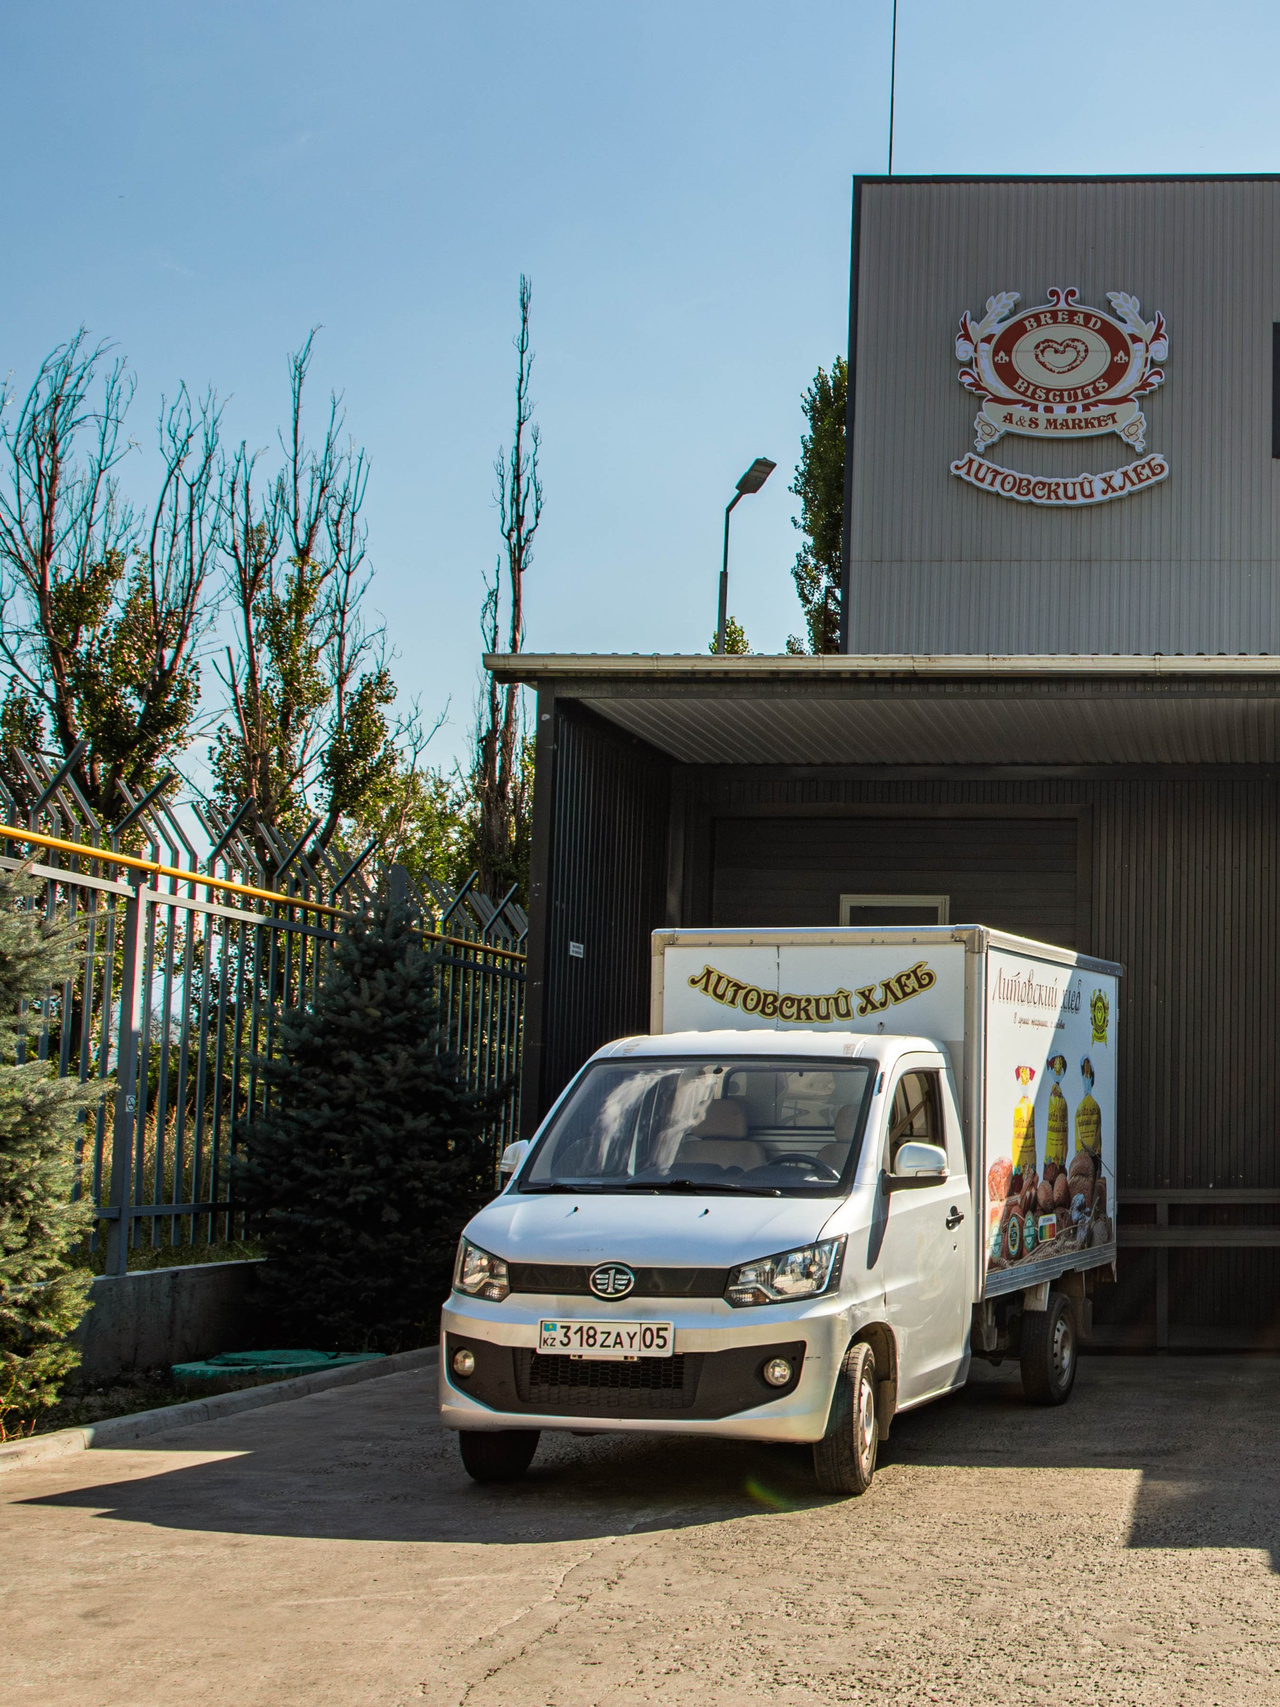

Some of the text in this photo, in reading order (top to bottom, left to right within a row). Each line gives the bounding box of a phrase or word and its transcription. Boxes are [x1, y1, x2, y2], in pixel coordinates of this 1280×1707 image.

[1022, 310, 1102, 333] BREAD
[1013, 377, 1109, 403] BISCUITS
[1044, 412, 1118, 430] MARKET
[953, 455, 1165, 501] ЛИТОВСКИЙ ХЛЕБ
[689, 963, 934, 1021] ЛИТОВСКИЙ ХЛЕБ
[542, 1337, 556, 1347] KZ
[642, 1327, 669, 1349] 05
